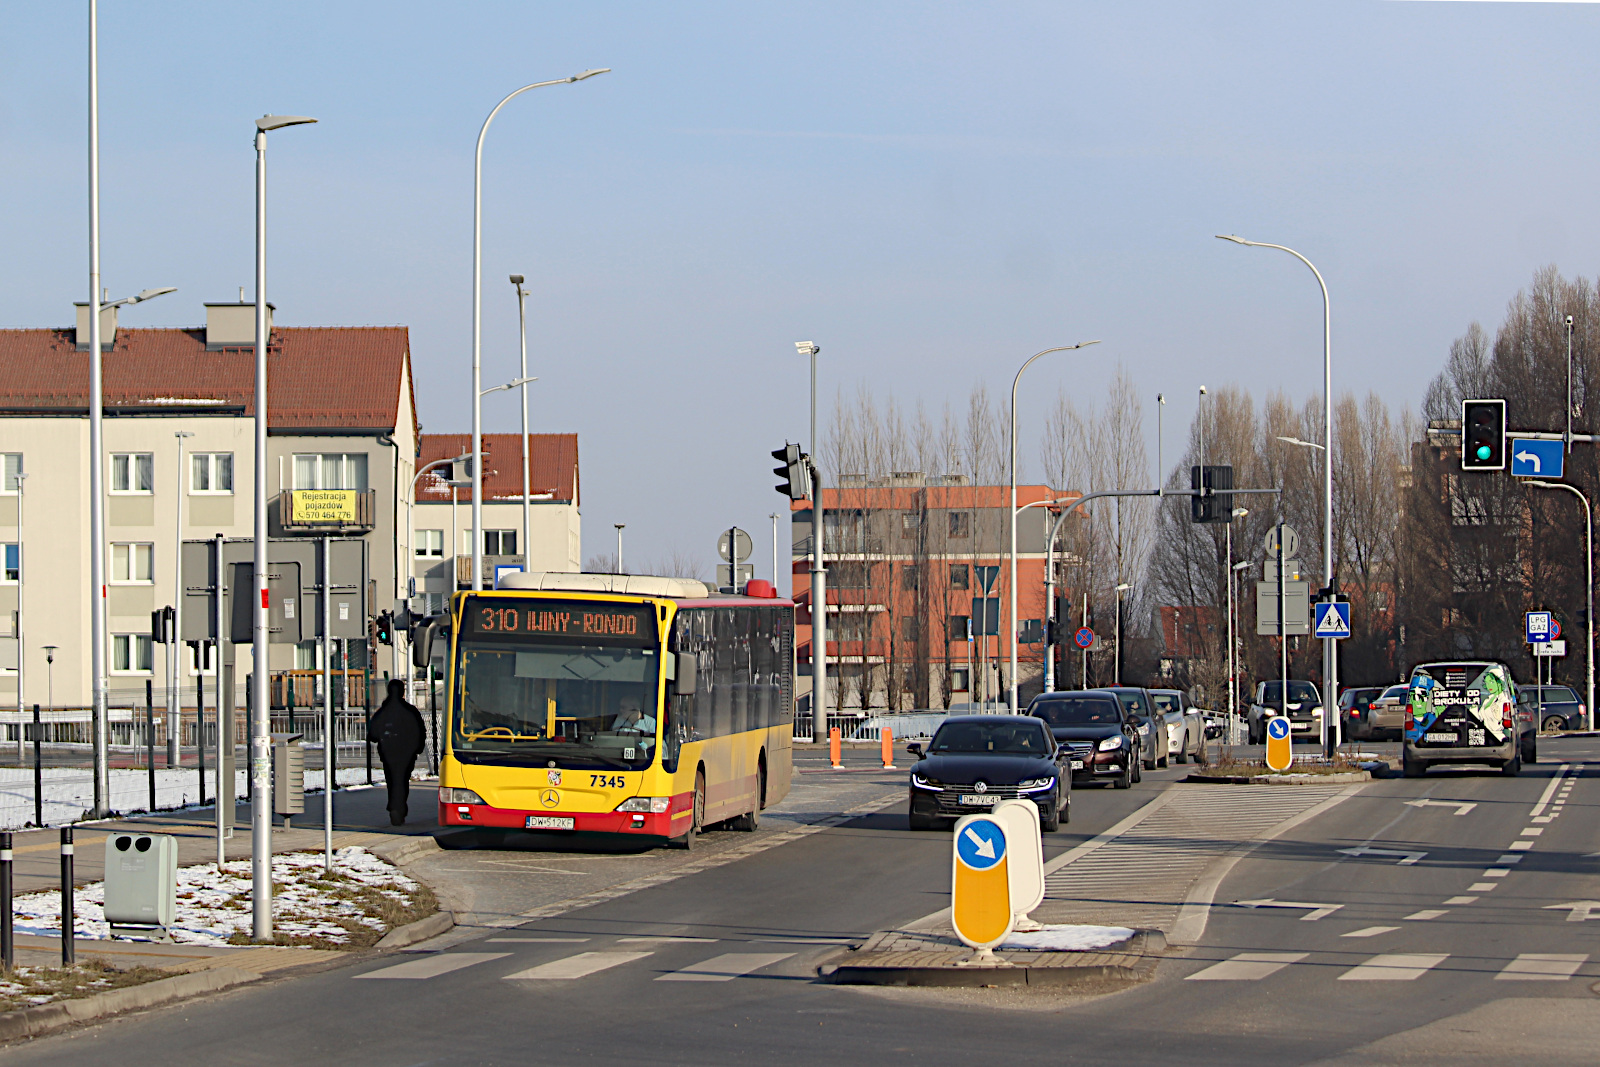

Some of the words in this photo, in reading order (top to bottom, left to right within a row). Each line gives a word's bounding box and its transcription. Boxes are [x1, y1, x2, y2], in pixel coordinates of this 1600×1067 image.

[302, 492, 346, 501] Rejestracja
[305, 501, 343, 510] pojazdów
[337, 511, 351, 519] 776
[481, 607, 519, 631] 310
[527, 610, 570, 632] IWINY
[583, 612, 637, 635] RONDO
[1530, 616, 1546, 624] LPG
[1434, 689, 1461, 698] DIETY
[1466, 689, 1480, 697] OD
[1434, 697, 1481, 705] BROKUŁA
[625, 749, 634, 758] 60
[590, 774, 625, 788] 7345
[531, 817, 543, 826] DW
[546, 817, 572, 827] 512KF
